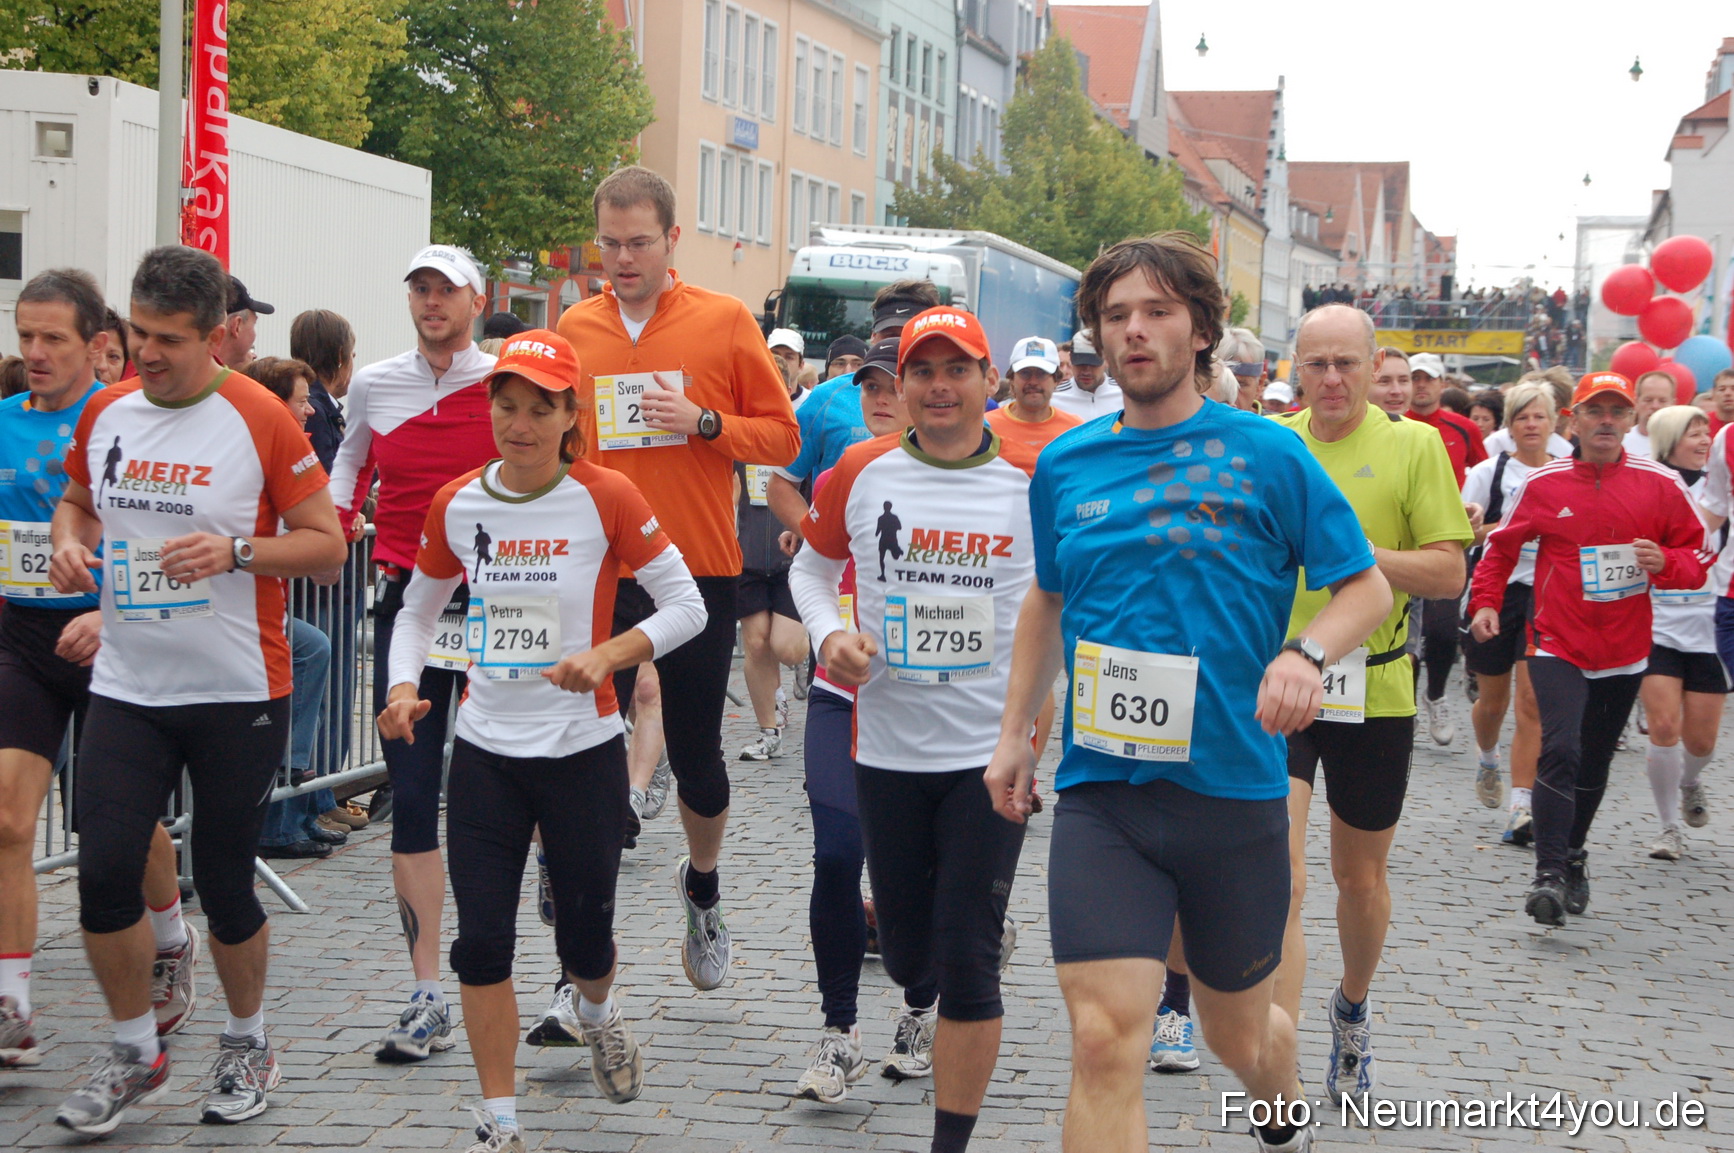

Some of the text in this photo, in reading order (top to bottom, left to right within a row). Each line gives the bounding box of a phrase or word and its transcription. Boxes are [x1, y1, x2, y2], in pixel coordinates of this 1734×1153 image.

[829, 253, 909, 272] BOCK
[914, 312, 967, 329] MERZ
[508, 340, 557, 360] MERZ
[1412, 333, 1470, 350] START
[617, 381, 645, 396] Sven
[598, 404, 605, 415] B
[651, 433, 687, 443] PFLEIDERER
[126, 459, 213, 487] MERZ
[117, 473, 187, 496] Reisen
[108, 497, 194, 516] TEAM 2008
[496, 539, 569, 557] MERZ
[911, 527, 1014, 558] MERZ
[21, 553, 53, 573] 62
[492, 551, 551, 567] Reisen
[904, 543, 988, 569] Reisen
[485, 572, 557, 583] TEAM 2008
[895, 569, 994, 589] TEAM 2008
[490, 605, 523, 619] Petra
[915, 605, 964, 620] Michael
[473, 627, 480, 640] C
[493, 629, 549, 651] 2794
[891, 627, 898, 640] C
[917, 630, 983, 653] 2795
[1103, 657, 1138, 682] Jens
[1077, 682, 1084, 697] B
[1110, 692, 1169, 728] 630
[1325, 708, 1363, 718] PFLEIDERER
[1137, 743, 1187, 756] PFLEIDERER
